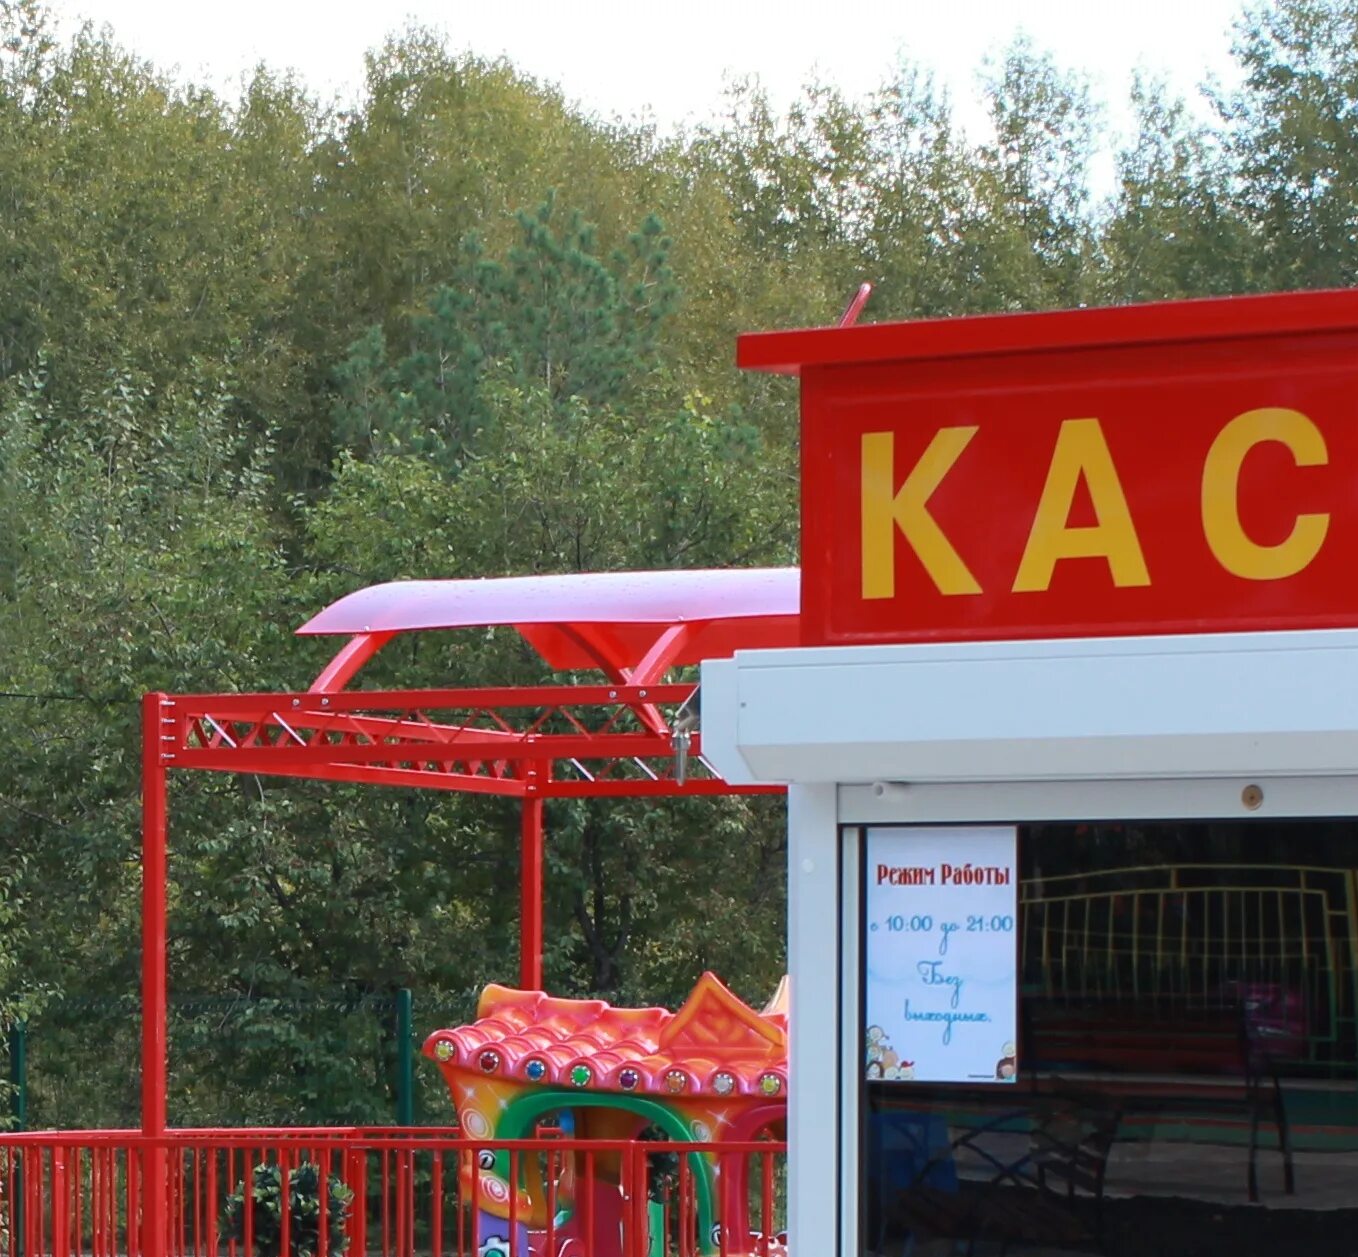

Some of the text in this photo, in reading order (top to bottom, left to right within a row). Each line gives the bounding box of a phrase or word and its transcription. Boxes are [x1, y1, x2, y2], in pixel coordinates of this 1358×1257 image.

[877, 863, 1011, 885] Режим Работы
[885, 915, 933, 932] 10:00
[939, 922, 960, 956] до
[966, 915, 1014, 932] 21:00
[917, 960, 963, 1009] Без
